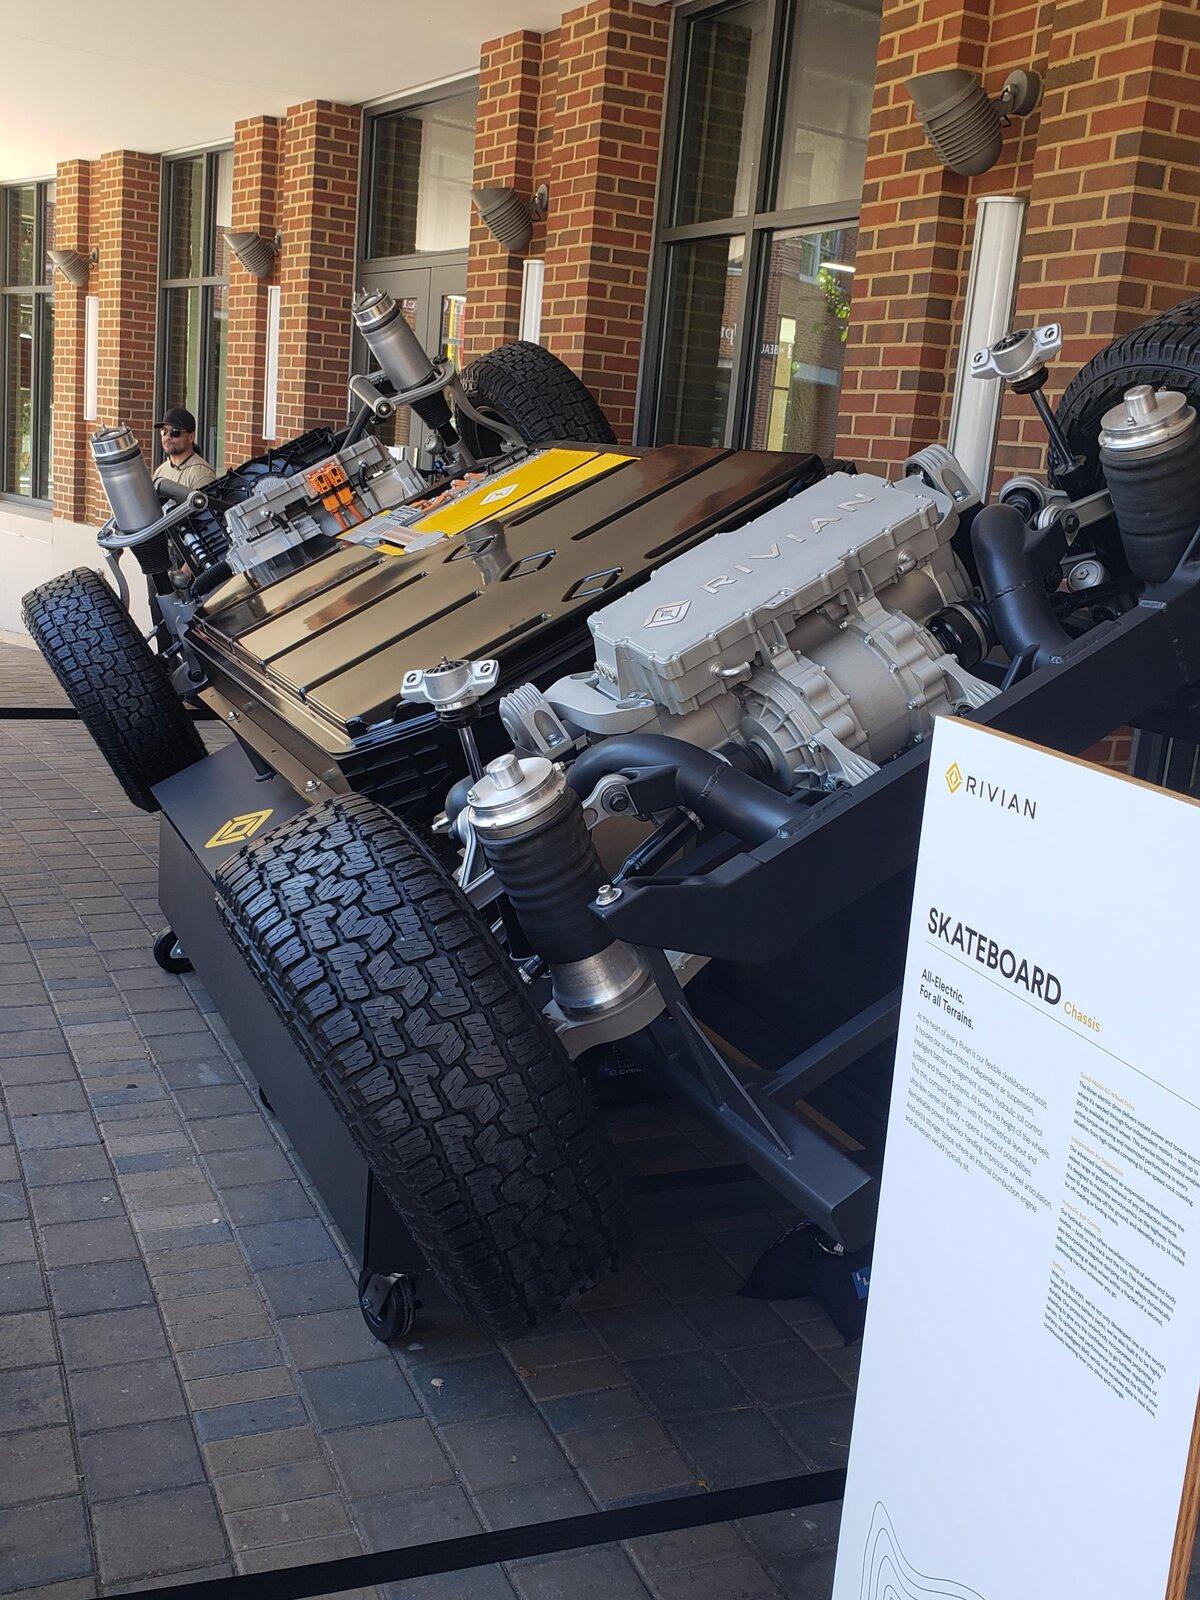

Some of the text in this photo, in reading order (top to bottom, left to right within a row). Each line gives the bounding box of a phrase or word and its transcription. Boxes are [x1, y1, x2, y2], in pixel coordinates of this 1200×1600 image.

[699, 492, 876, 594] RIVIAN
[966, 775, 1037, 819] RIVIAN
[921, 968, 965, 1006] All-Electric.
[927, 907, 1101, 1033] SKATEBOARD Chassis
[919, 984, 975, 1031] For all Terrains.
